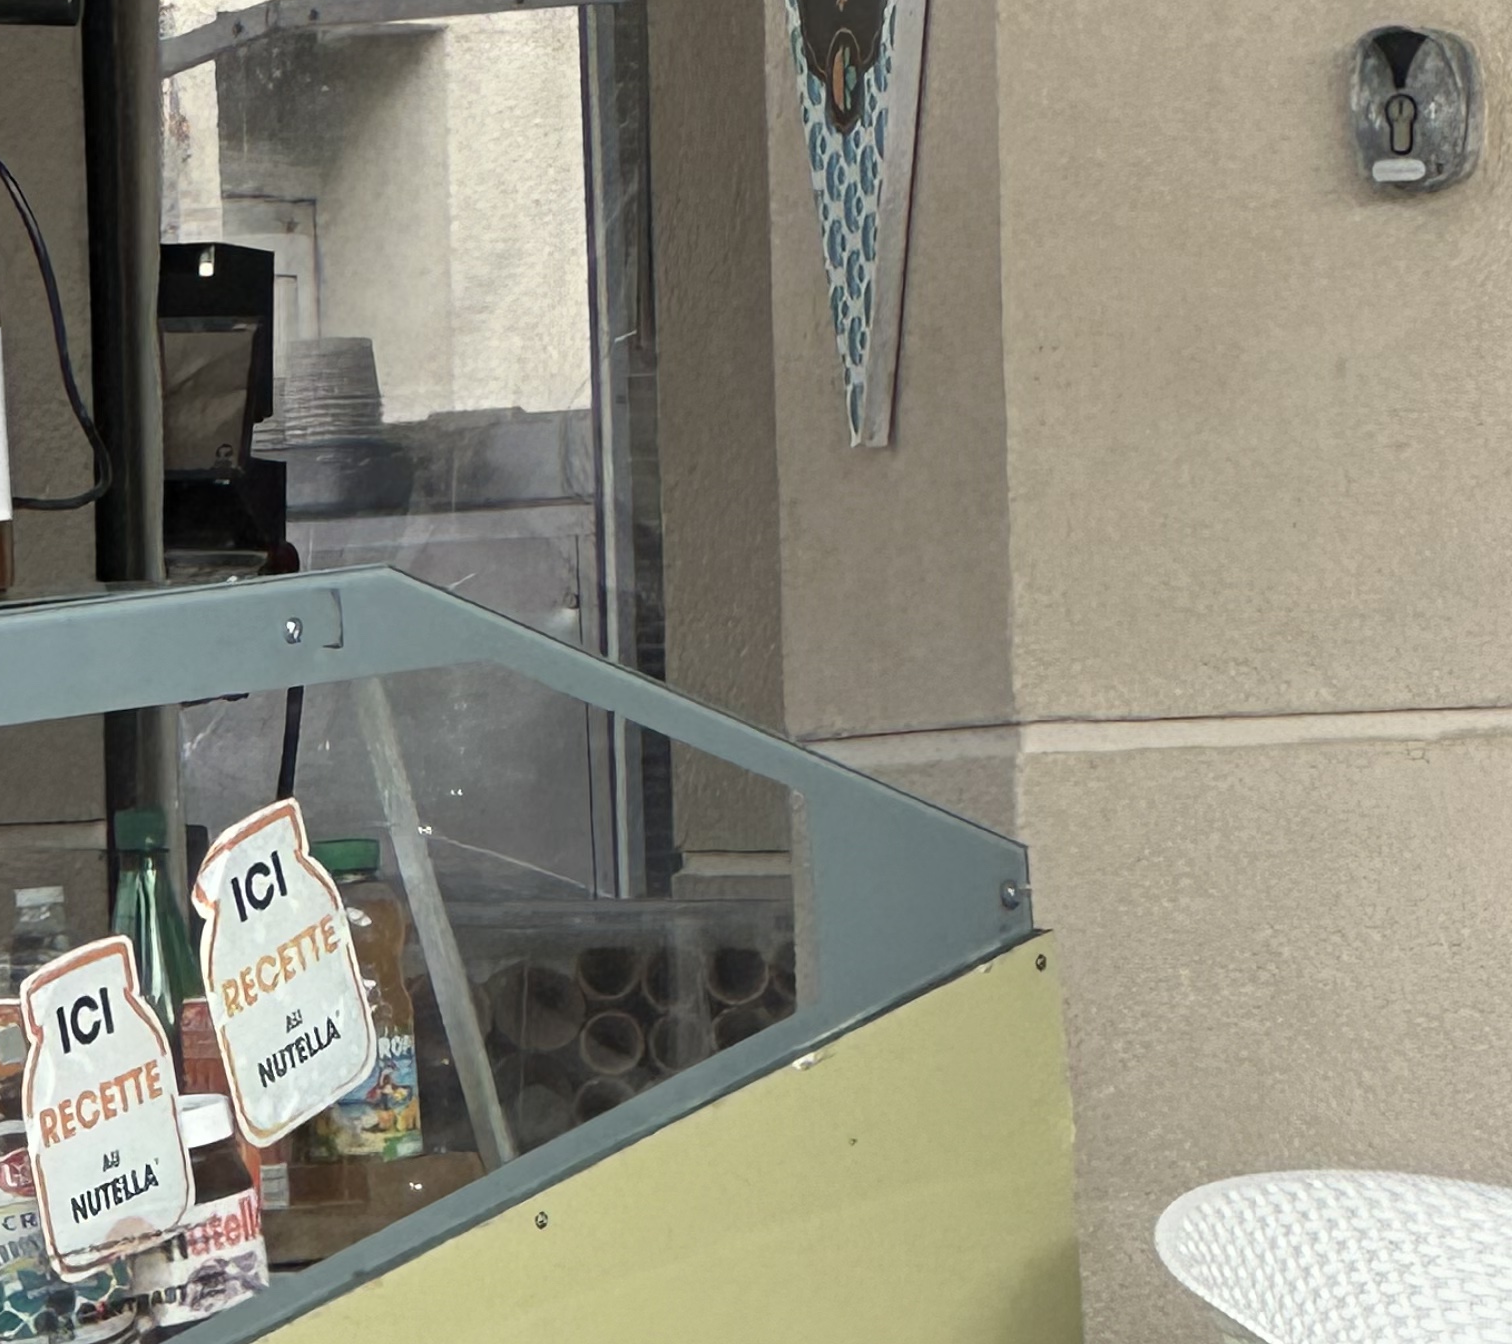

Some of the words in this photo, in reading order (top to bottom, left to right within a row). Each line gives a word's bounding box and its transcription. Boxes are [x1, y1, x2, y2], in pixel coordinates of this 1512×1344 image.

[231, 850, 287, 923] ICI
[221, 913, 341, 1019] RECETTE
[56, 987, 115, 1054] ICI
[39, 1059, 163, 1148] RECETTE
